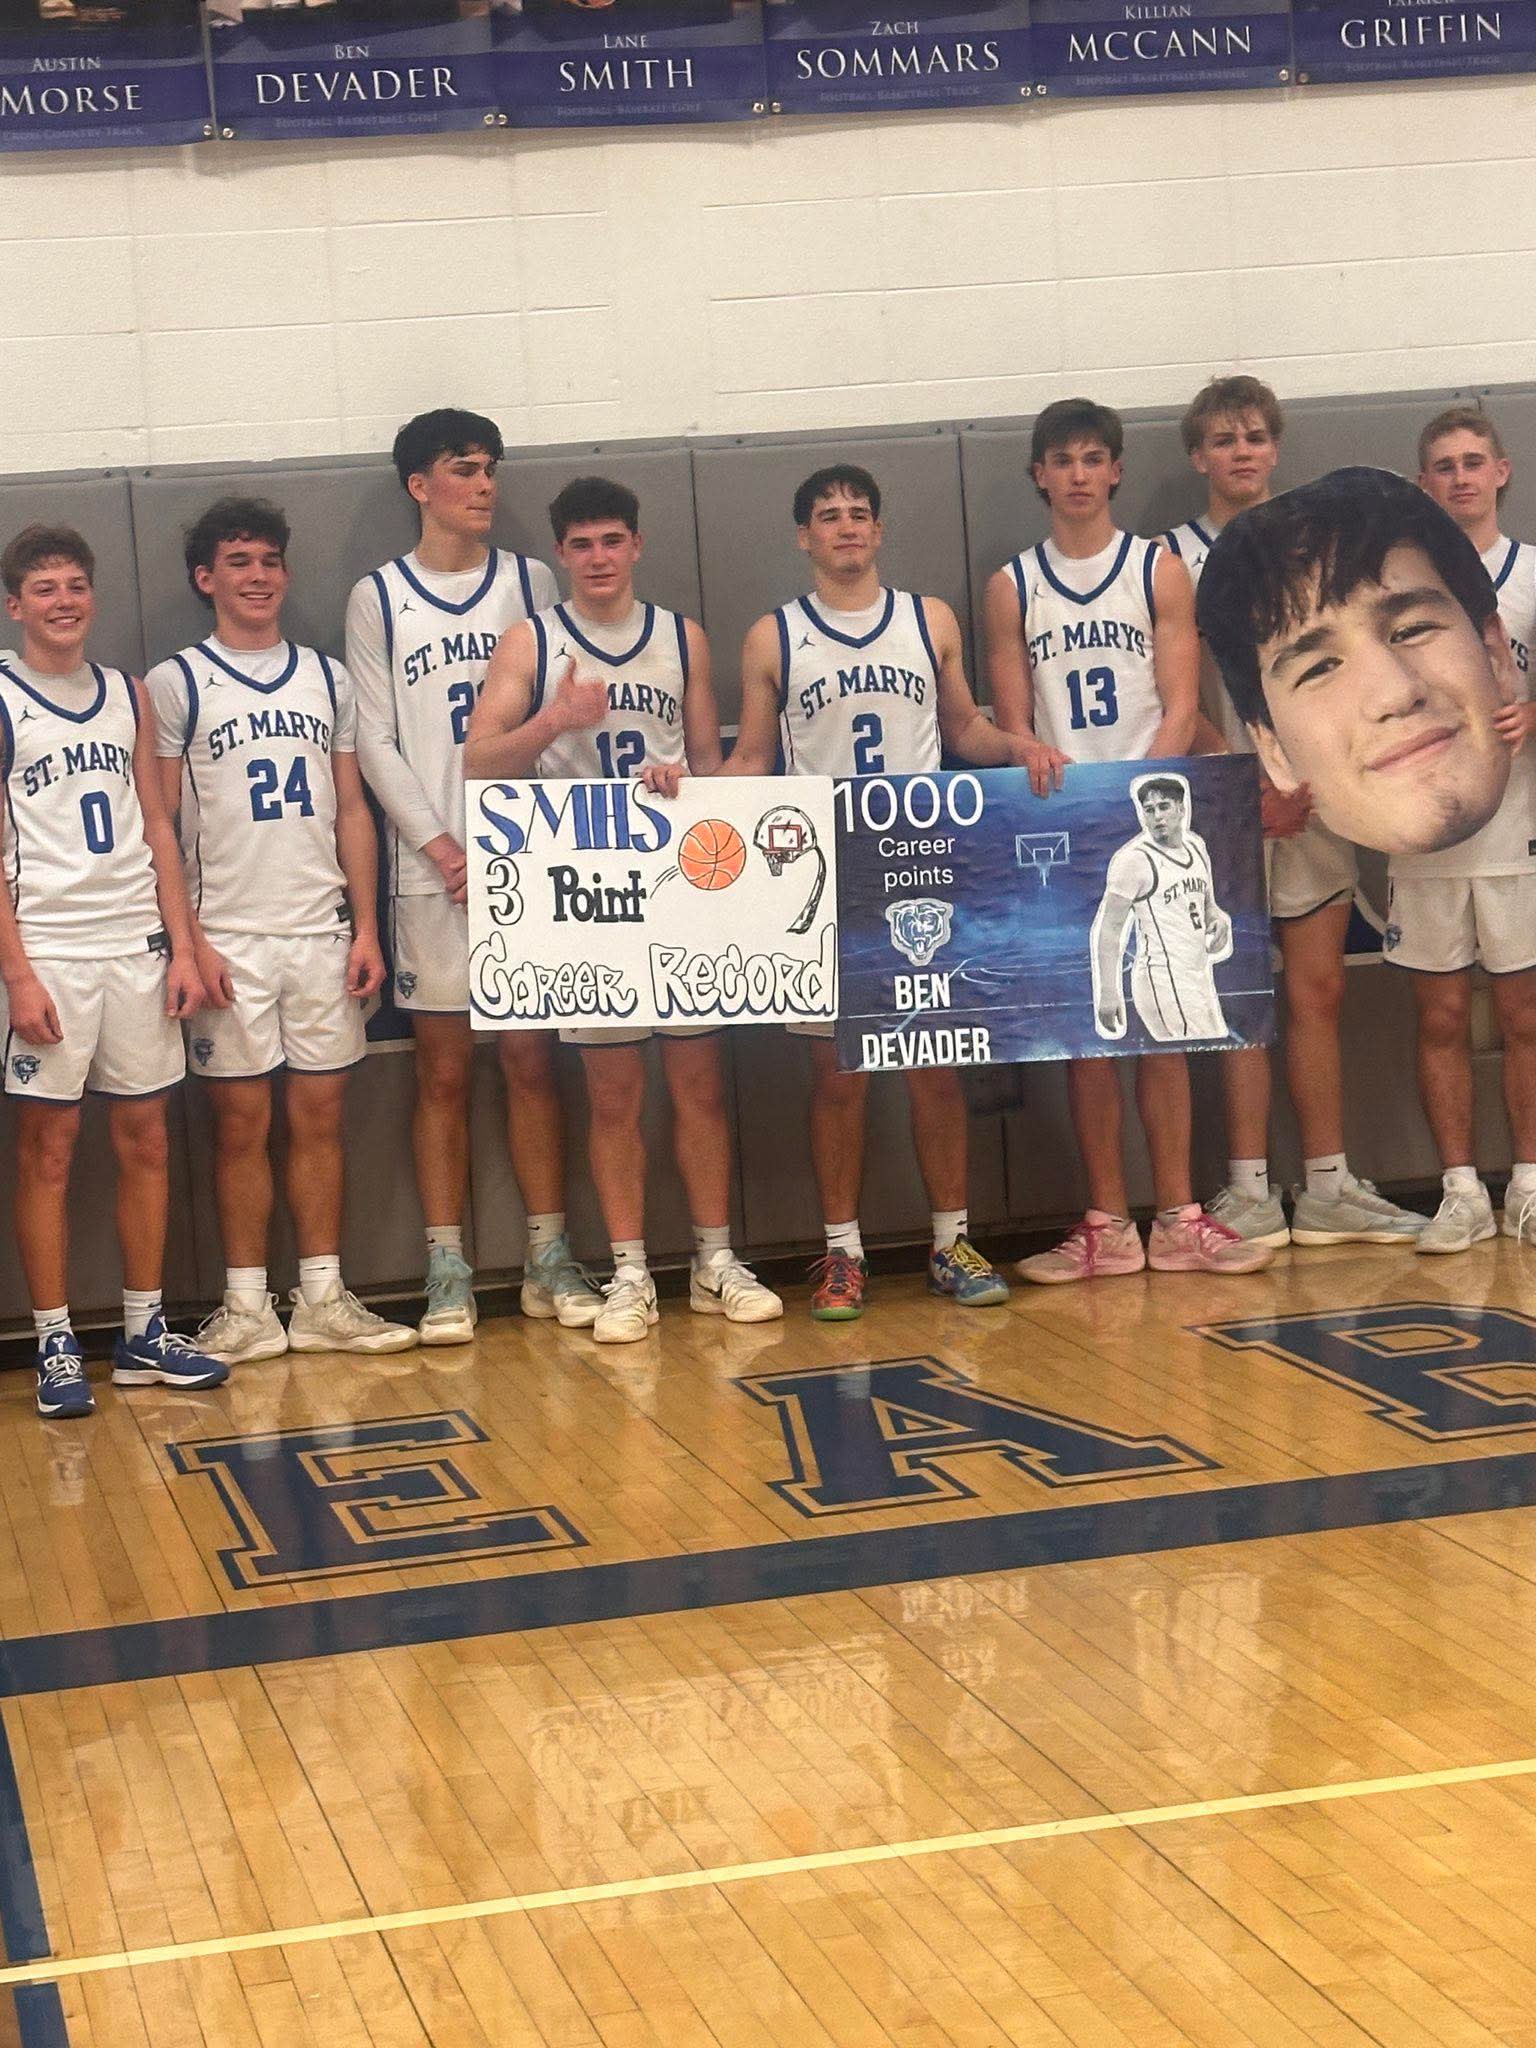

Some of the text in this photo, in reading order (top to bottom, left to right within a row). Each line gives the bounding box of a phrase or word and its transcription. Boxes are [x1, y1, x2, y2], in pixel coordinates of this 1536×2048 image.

[870, 20, 919, 36] ZACH
[1125, 4, 1192, 20] KILLIAN
[1341, 12, 1502, 50] GRIFFIN
[334, 44, 370, 60] BEN
[604, 34, 649, 49] LANE
[796, 41, 1000, 81] SOMMARS
[1068, 25, 1252, 63] MCCANN
[31, 56, 101, 73] AUSTIN
[559, 57, 695, 93] SMITH
[1, 84, 143, 117] MORSE
[255, 67, 458, 105] DEVADER
[404, 632, 501, 686] ST. MAR
[1063, 621, 1146, 658] MARYS
[800, 664, 926, 720] ST. MARYS
[1066, 667, 1119, 730] 13
[448, 680, 485, 745] 2
[208, 709, 330, 760] ST. MARYS
[596, 730, 646, 778] 12
[852, 713, 884, 775] 2
[23, 753, 59, 797] ST.
[247, 757, 315, 821] 24
[80, 790, 115, 854] 0
[473, 781, 672, 855] SMHS
[834, 773, 984, 833] 1000
[878, 837, 955, 858] Career
[485, 857, 647, 927] 3 Point
[884, 866, 954, 892] points
[894, 972, 950, 1010] BEN
[862, 1027, 991, 1069] DEVADER
